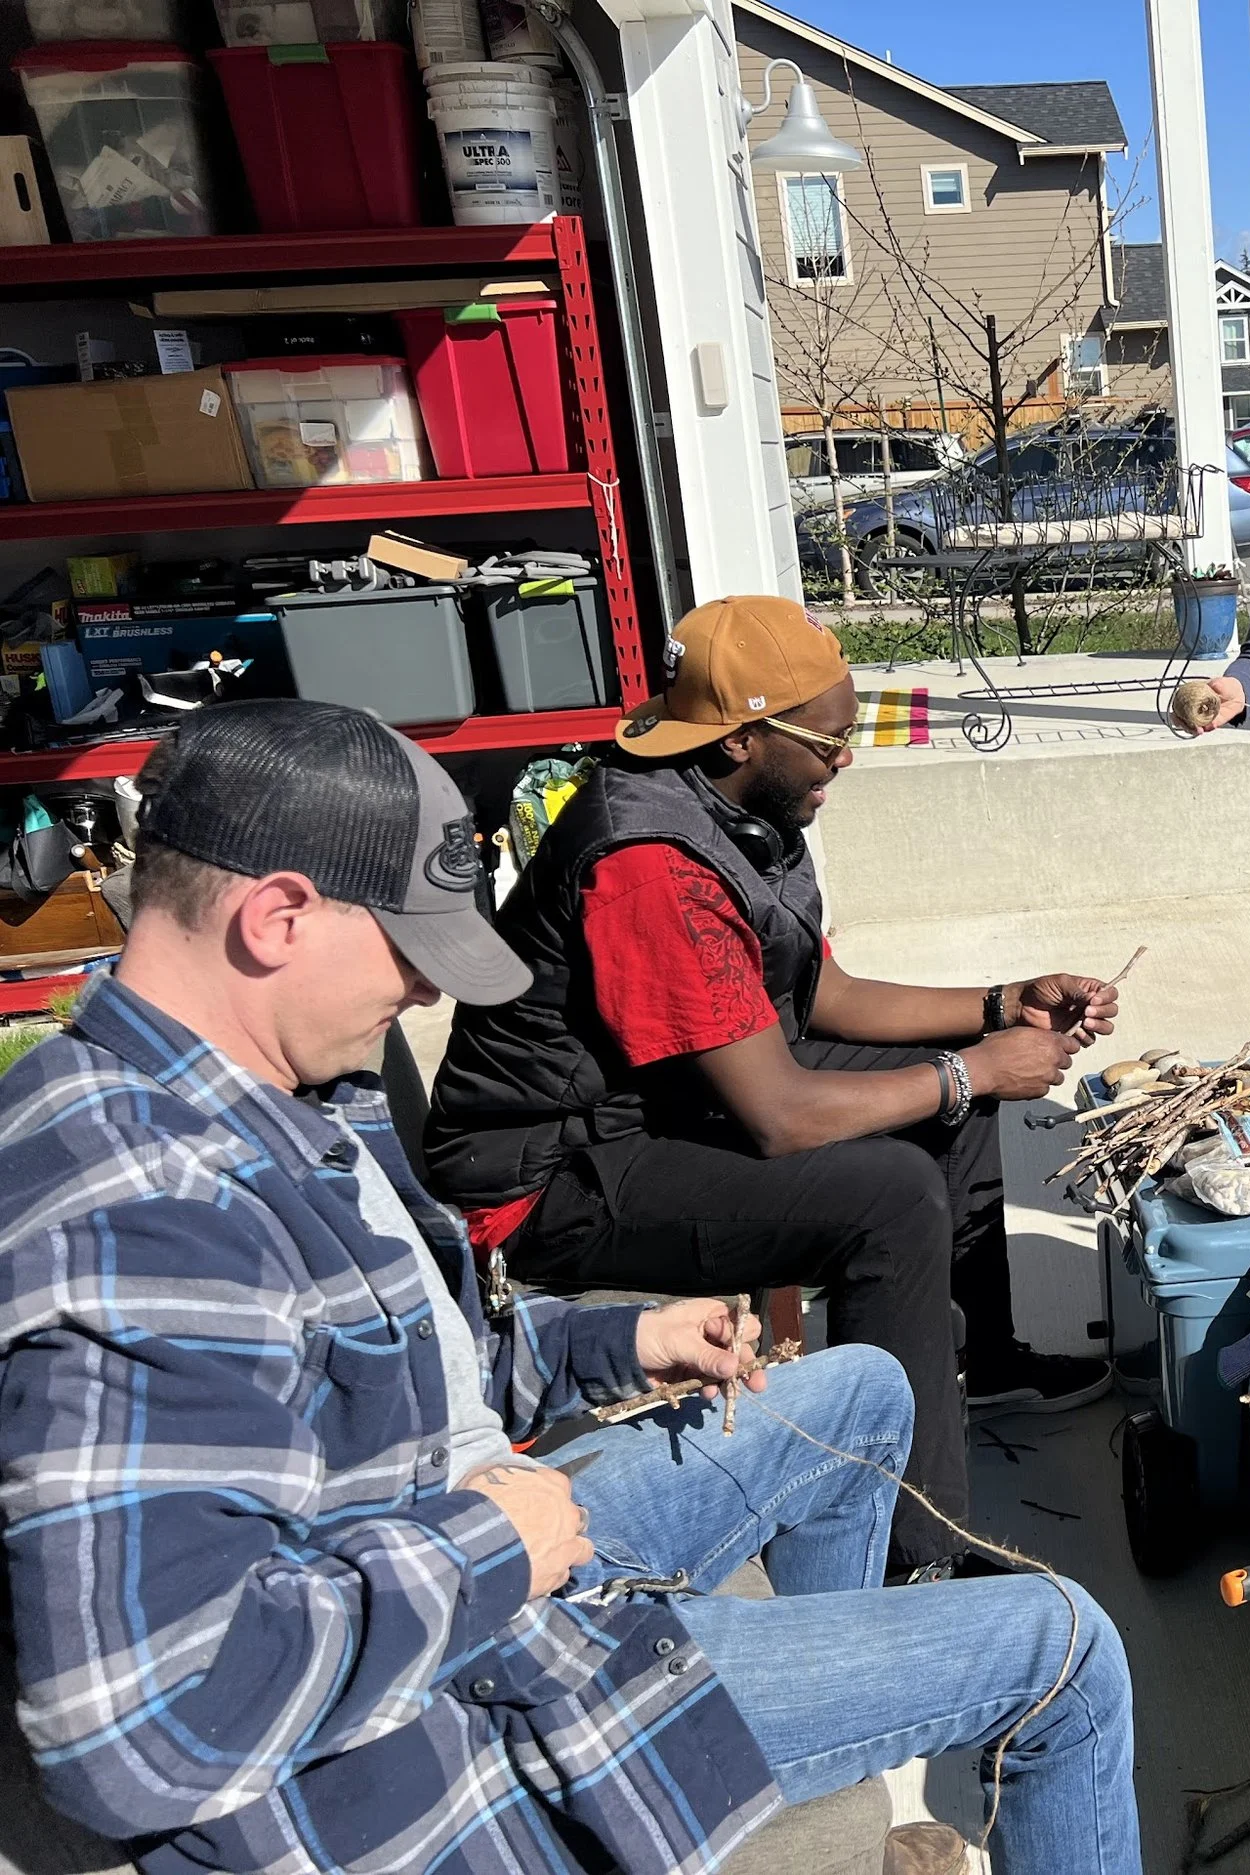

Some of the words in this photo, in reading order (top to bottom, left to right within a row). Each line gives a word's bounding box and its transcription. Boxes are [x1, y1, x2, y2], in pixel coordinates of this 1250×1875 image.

[463, 145, 510, 158] ULTRA
[474, 158, 494, 166] SPEC
[496, 158, 511, 166] 500
[85, 627, 111, 638] LXT
[113, 627, 173, 638] BRUSHLESS
